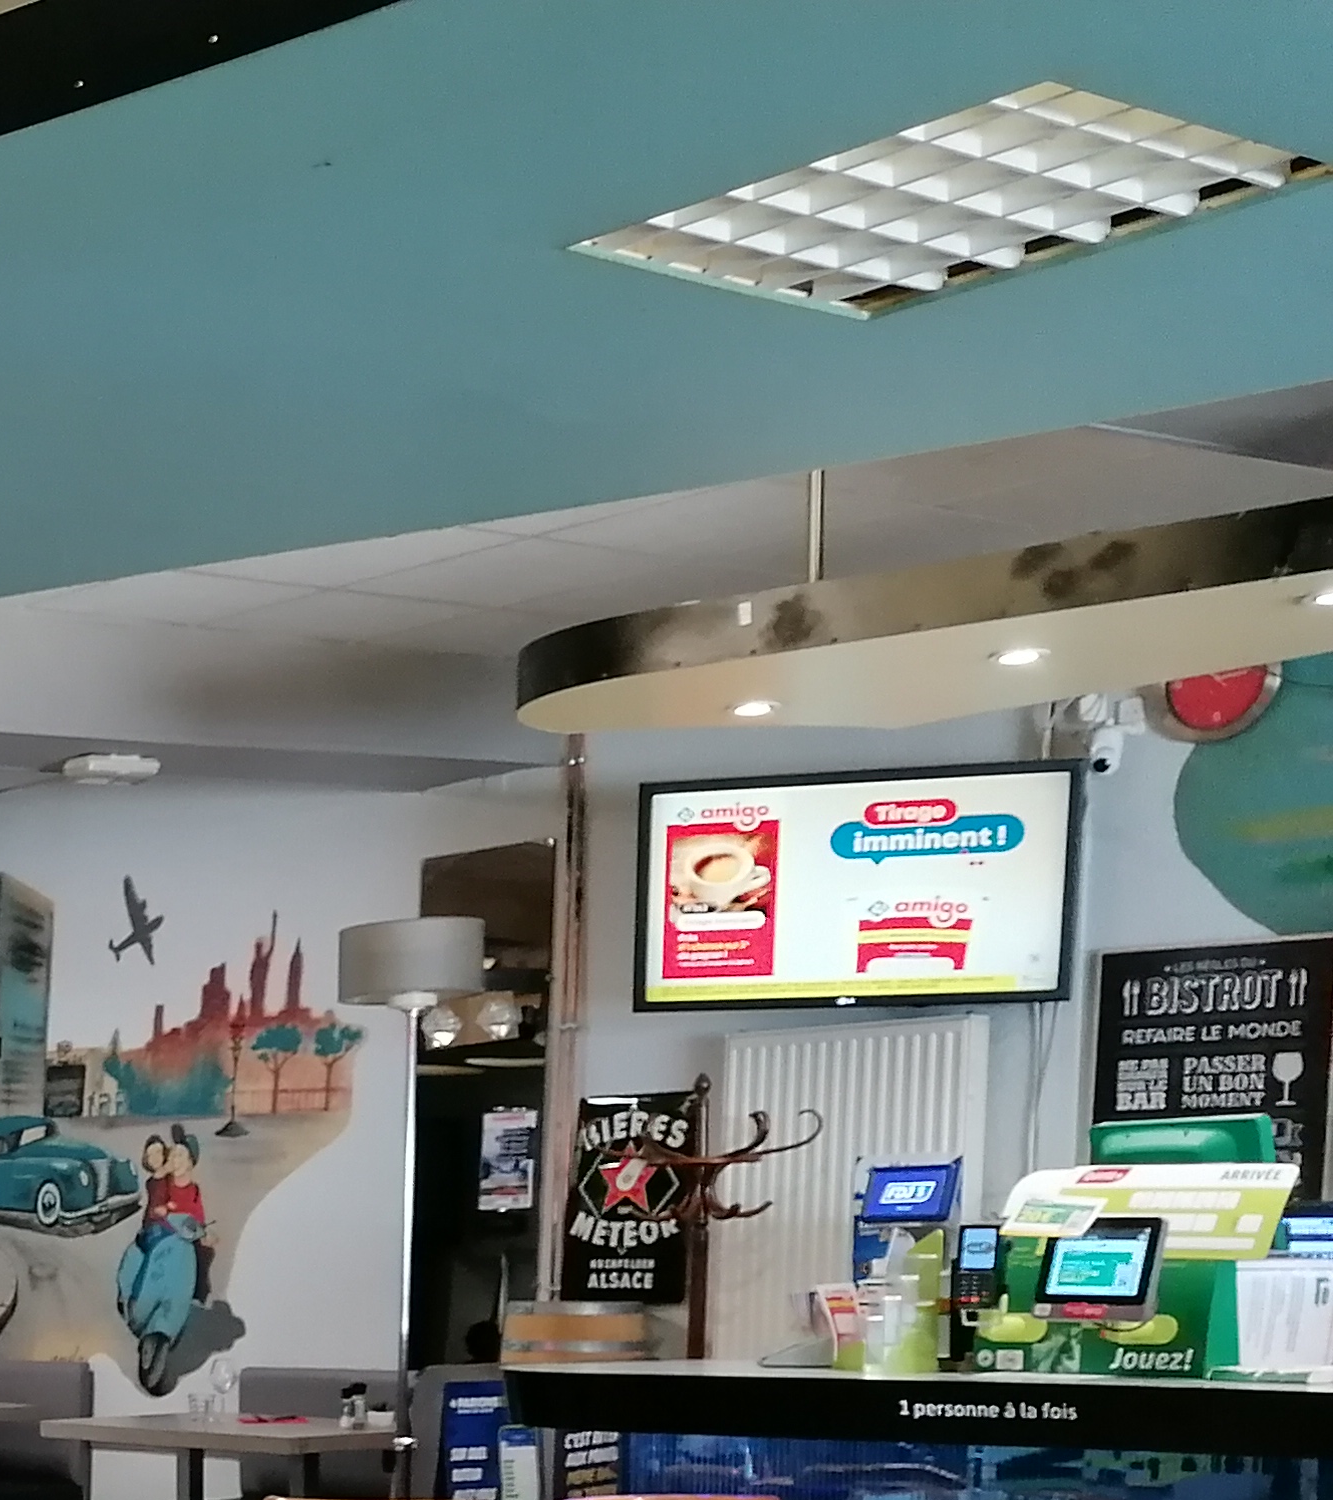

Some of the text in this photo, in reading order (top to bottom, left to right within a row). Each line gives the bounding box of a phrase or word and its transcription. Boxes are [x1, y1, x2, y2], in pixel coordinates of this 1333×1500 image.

[700, 801, 770, 827] amigo
[874, 802, 948, 823] Tirage
[852, 827, 993, 853] imminent
[894, 895, 969, 923] amigo
[1145, 969, 1284, 1017] BISTROT
[1121, 1020, 1303, 1045] REFAIRE LE MONDE
[1184, 1054, 1266, 1075] PASSER
[1184, 1075, 1214, 1093] UN
[1218, 1073, 1265, 1092] BON
[1181, 1092, 1266, 1110] MOMENT
[1220, 1168, 1283, 1181] ARRIVÉE
[587, 1271, 654, 1289] ALSACE
[1108, 1347, 1195, 1371] Jouez!
[899, 1399, 1078, 1421] 1 personne à la fois
